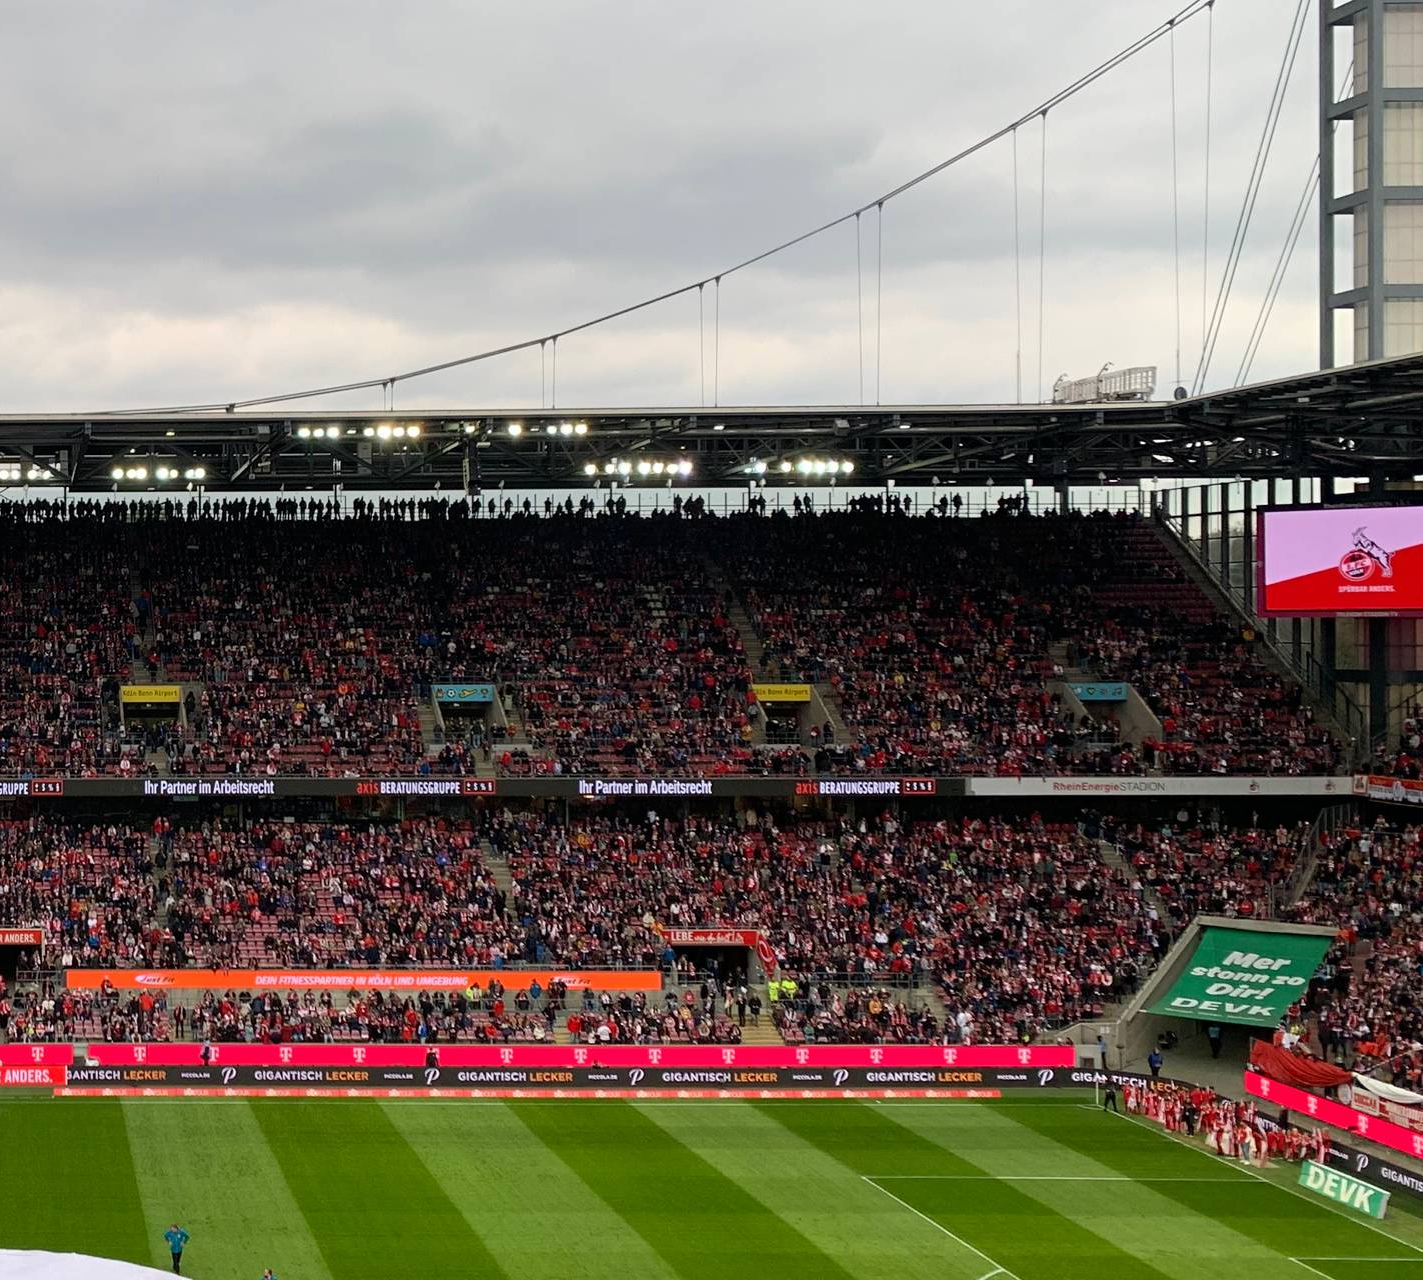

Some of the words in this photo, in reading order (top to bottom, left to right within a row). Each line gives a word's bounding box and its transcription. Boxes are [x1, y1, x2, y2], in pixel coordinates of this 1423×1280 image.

[144, 780, 159, 794] Ihr
[160, 780, 198, 794] Partner
[198, 780, 212, 794] im
[213, 780, 275, 794] Arbeitsrecht
[357, 780, 379, 794] axis
[380, 781, 461, 794] BERATUNGSGRUPPE
[578, 780, 593, 794] Ihr
[595, 780, 633, 794] Partner
[634, 780, 649, 794] im
[650, 779, 713, 794] Arbeitsrecht
[796, 779, 818, 794] axis
[819, 781, 900, 794] BERATUNGSGRUPPE
[4, 933, 36, 943] ANDERS.
[671, 931, 693, 941] LEBE
[1222, 951, 1291, 970] Mer
[256, 976, 277, 985] DEIN
[278, 976, 354, 986] FITNESSPARTNER
[355, 976, 367, 985] IN
[394, 976, 414, 985] UND
[416, 976, 468, 986] UMGEBUNG
[1190, 966, 1269, 983] stonn
[1271, 975, 1306, 986] zo
[1206, 983, 1274, 1000] Dir!
[1170, 997, 1277, 1017] DEVK
[4, 1069, 53, 1083] ANDERS.
[67, 1070, 121, 1081] GANTISCH
[123, 1070, 167, 1081] LECKER
[254, 1070, 323, 1081] GIGANTISCH
[325, 1070, 369, 1081] LECKER
[457, 1071, 527, 1082] GIGANTISCH
[529, 1071, 573, 1082] LECKER
[661, 1072, 731, 1083] GIGANTISCH
[733, 1072, 778, 1083] LECKER
[866, 1071, 936, 1082] GIGANTISCH
[938, 1071, 983, 1082] LECKER
[1071, 1072, 1147, 1088] GIGATISCH
[1381, 1167, 1423, 1192] GIGANTIS
[1306, 1164, 1374, 1213] DEVK
